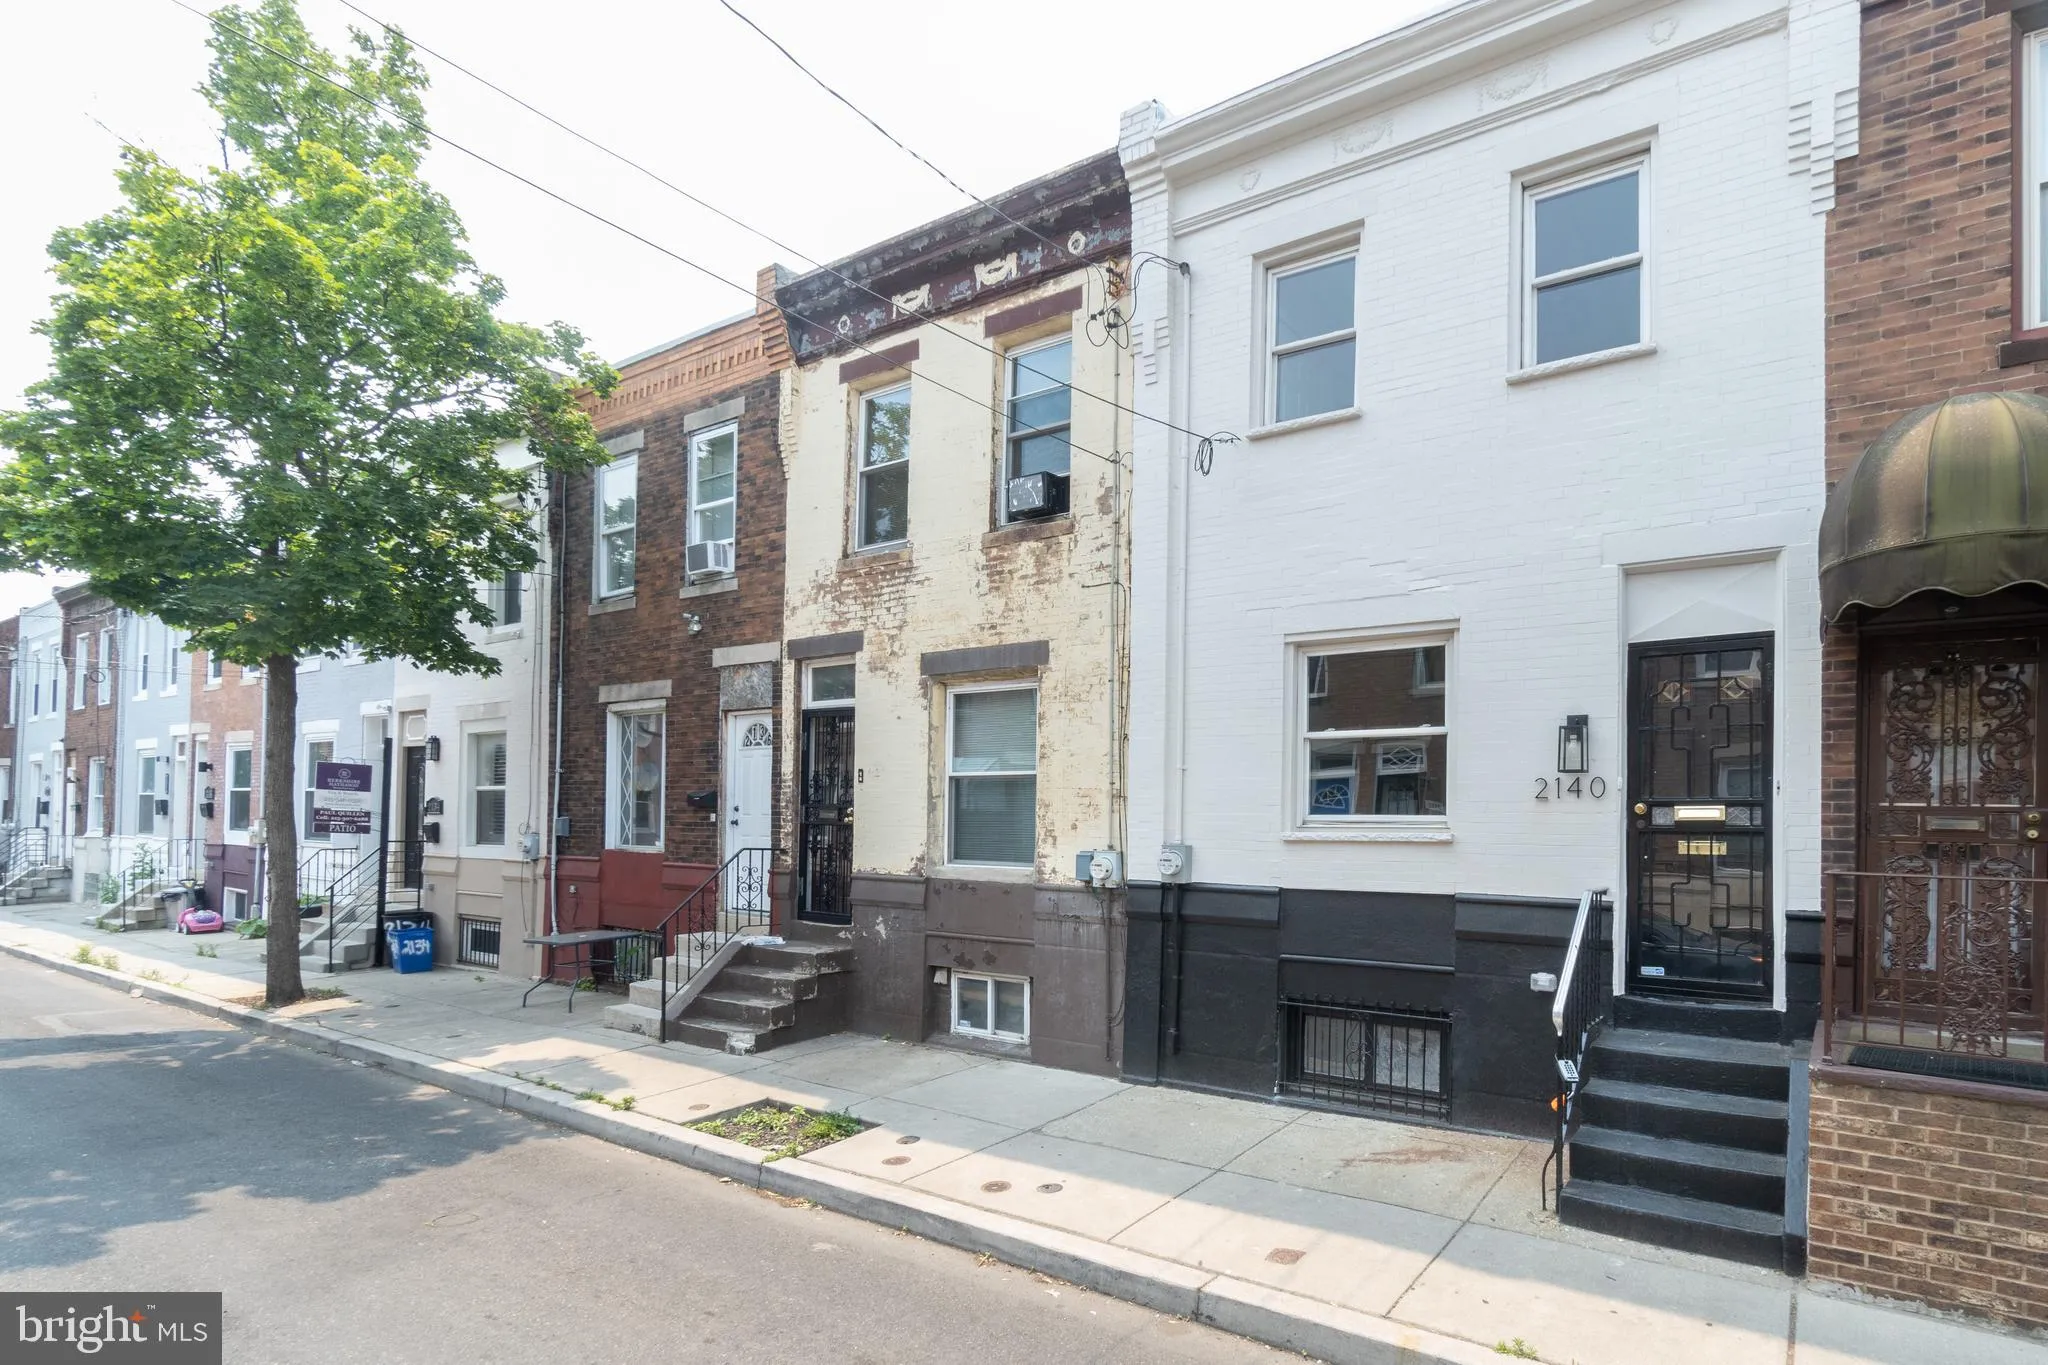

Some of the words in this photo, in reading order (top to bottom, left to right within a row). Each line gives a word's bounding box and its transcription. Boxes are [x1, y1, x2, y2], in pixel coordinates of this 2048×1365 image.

[744, 725, 771, 746] 2136
[1534, 776, 1606, 799] 2140
[329, 824, 357, 833] PATIO
[401, 939, 430, 955] 2134
